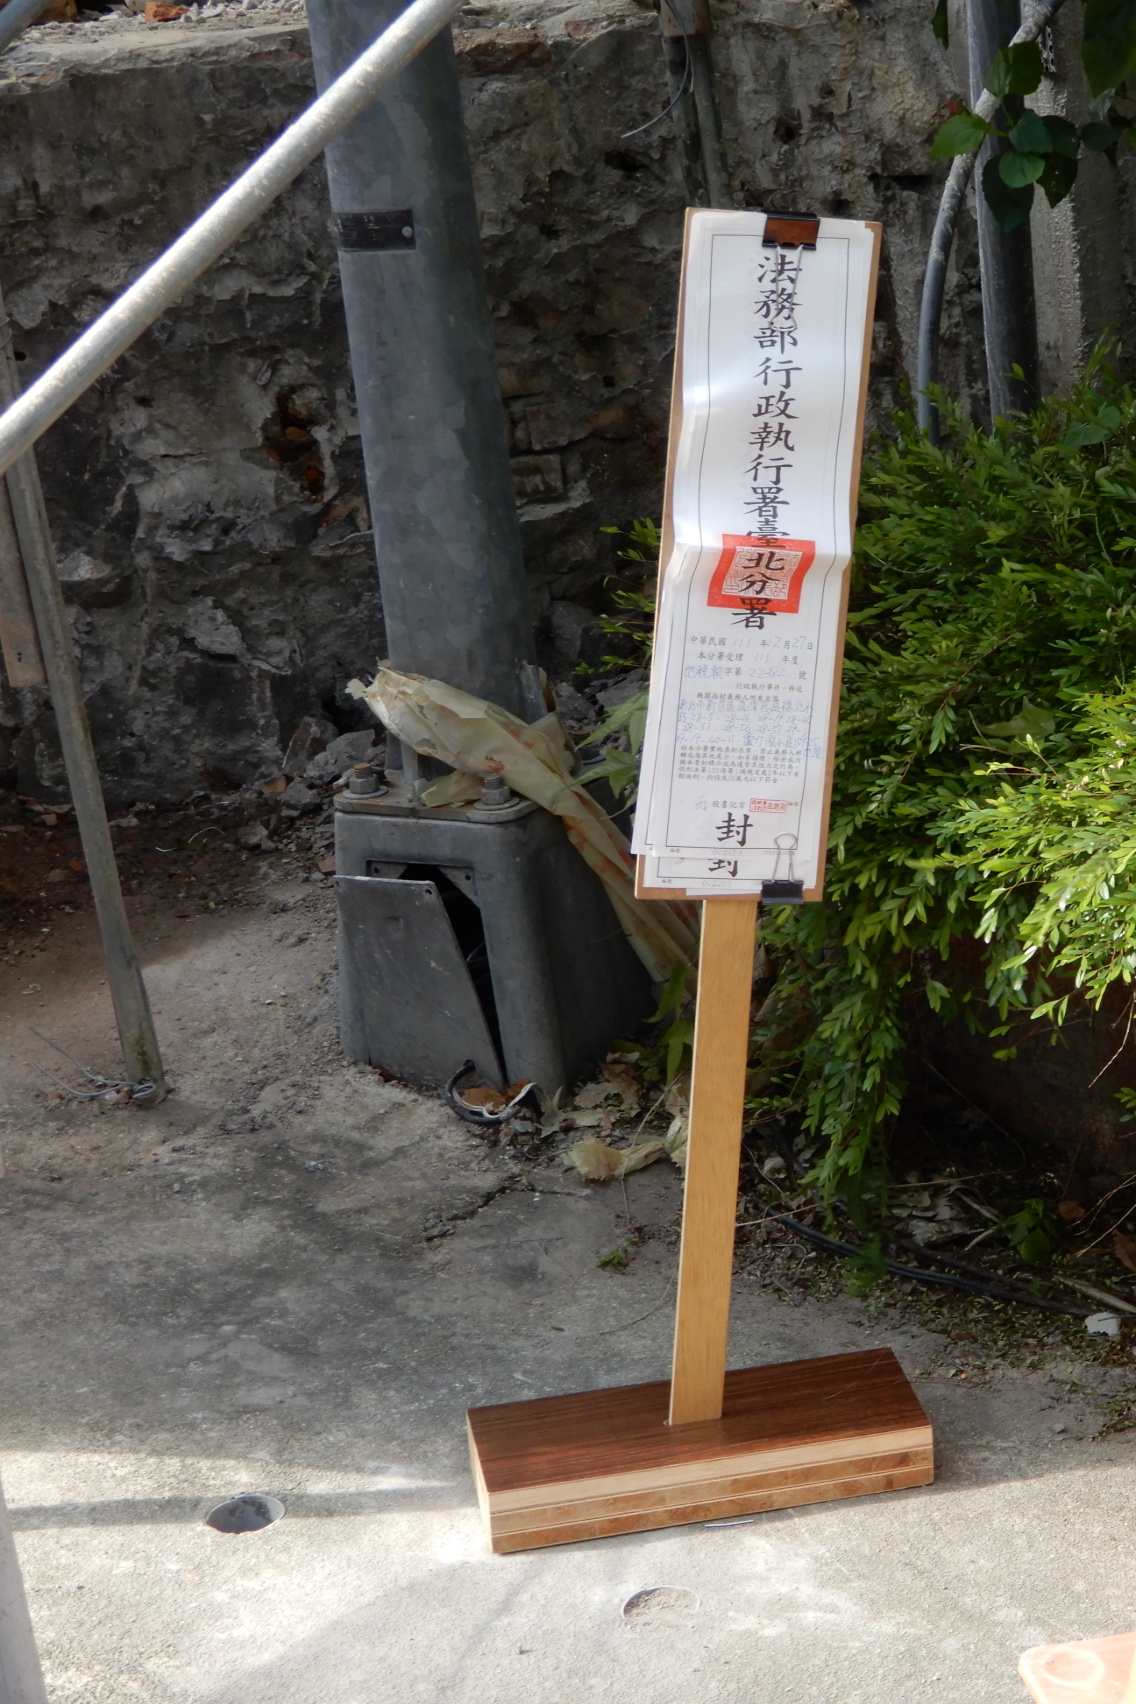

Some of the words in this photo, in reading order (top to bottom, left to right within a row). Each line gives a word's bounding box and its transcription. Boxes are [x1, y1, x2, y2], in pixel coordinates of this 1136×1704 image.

[730, 254, 803, 630] 法務部行政執行署臺北分署
[690, 635, 727, 647] 中華民國
[697, 650, 744, 662] 本分署受理
[781, 655, 800, 666] 年度
[798, 670, 808, 681] 號
[716, 812, 754, 847] 封
